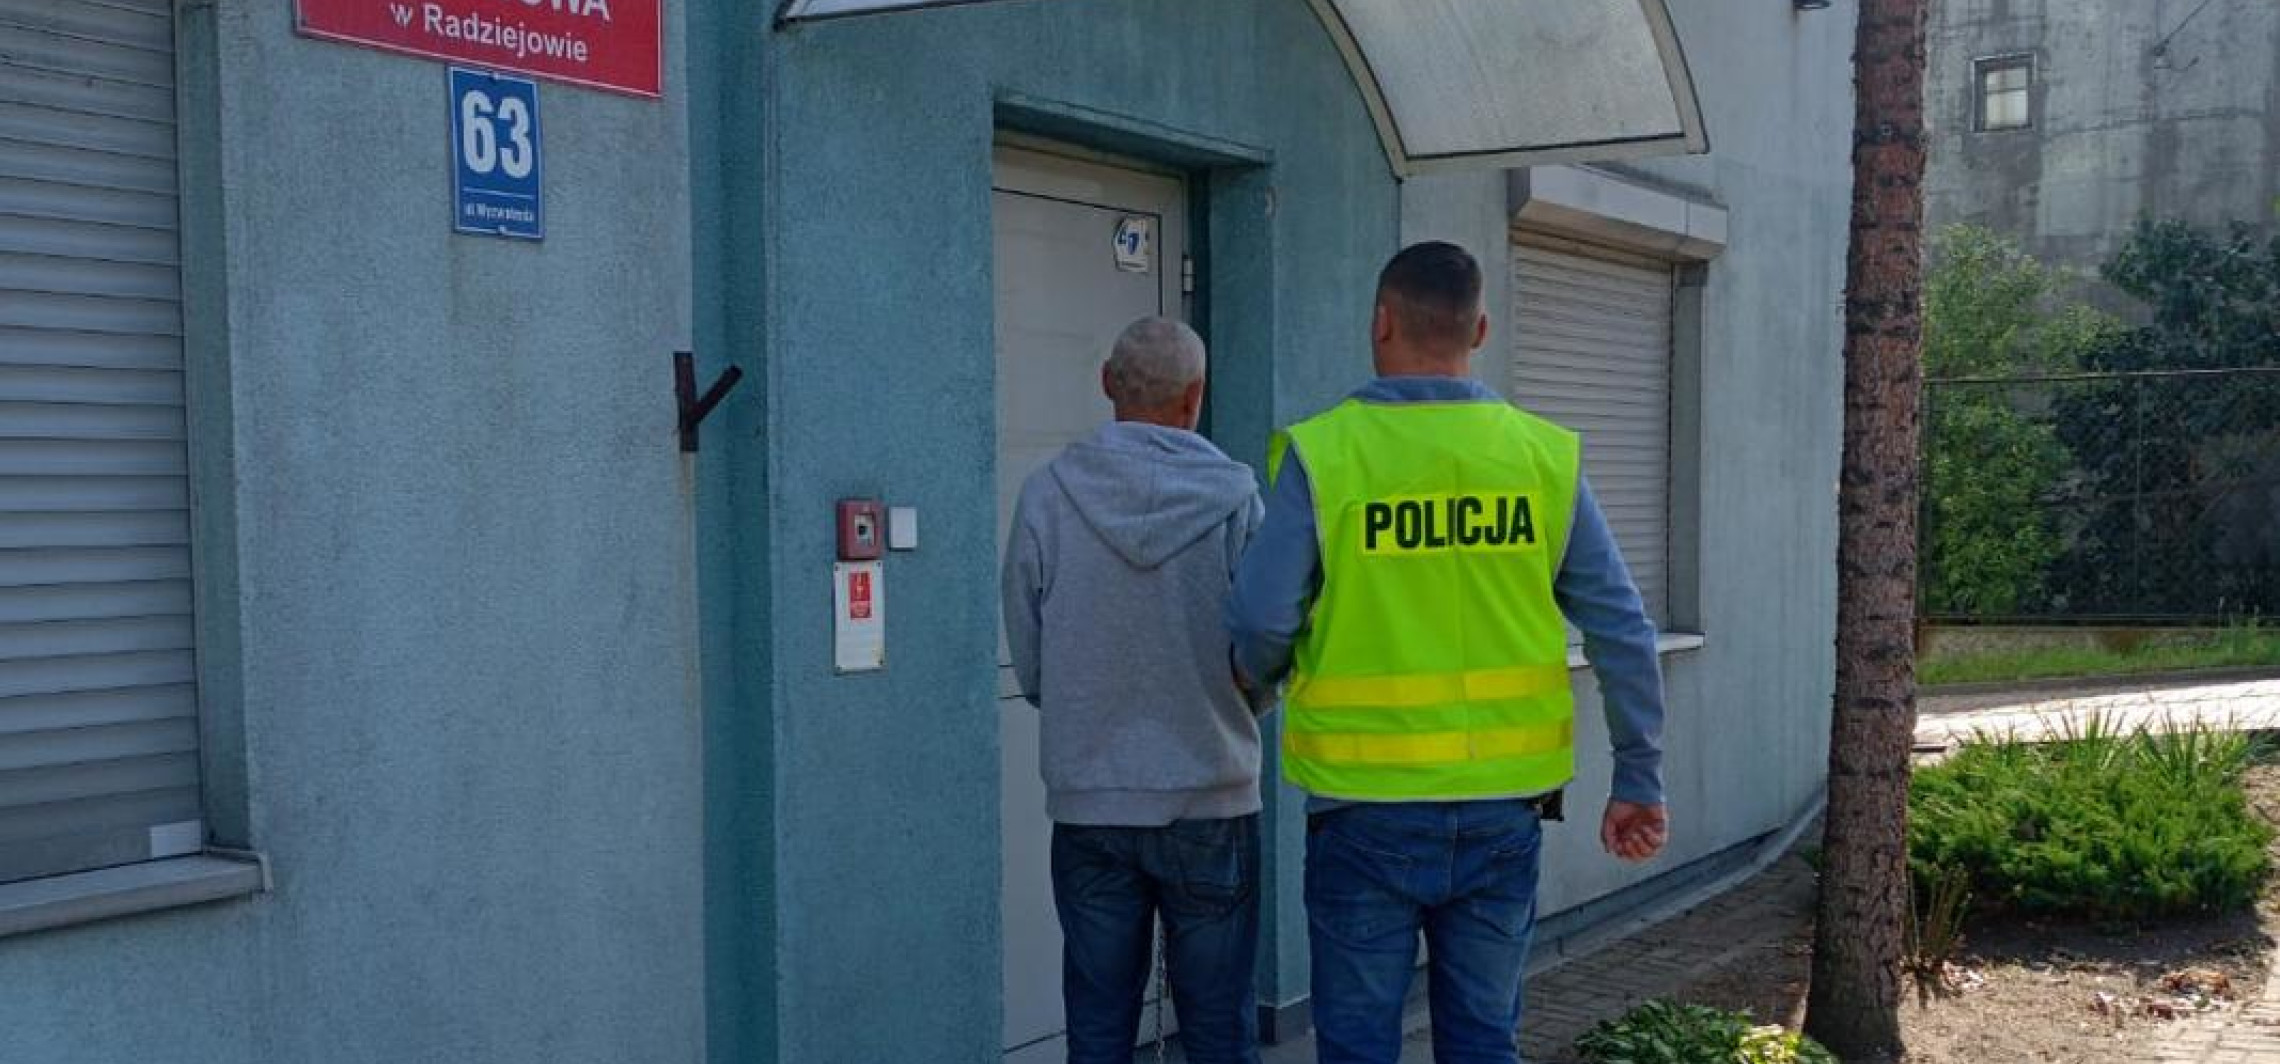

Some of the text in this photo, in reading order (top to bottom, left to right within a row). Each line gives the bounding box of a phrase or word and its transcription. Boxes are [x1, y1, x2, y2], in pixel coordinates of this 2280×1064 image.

[390, 2, 413, 28] w
[424, 3, 588, 62] Radziejowie
[461, 89, 533, 179] 63
[1365, 496, 1536, 550] POLICJA
